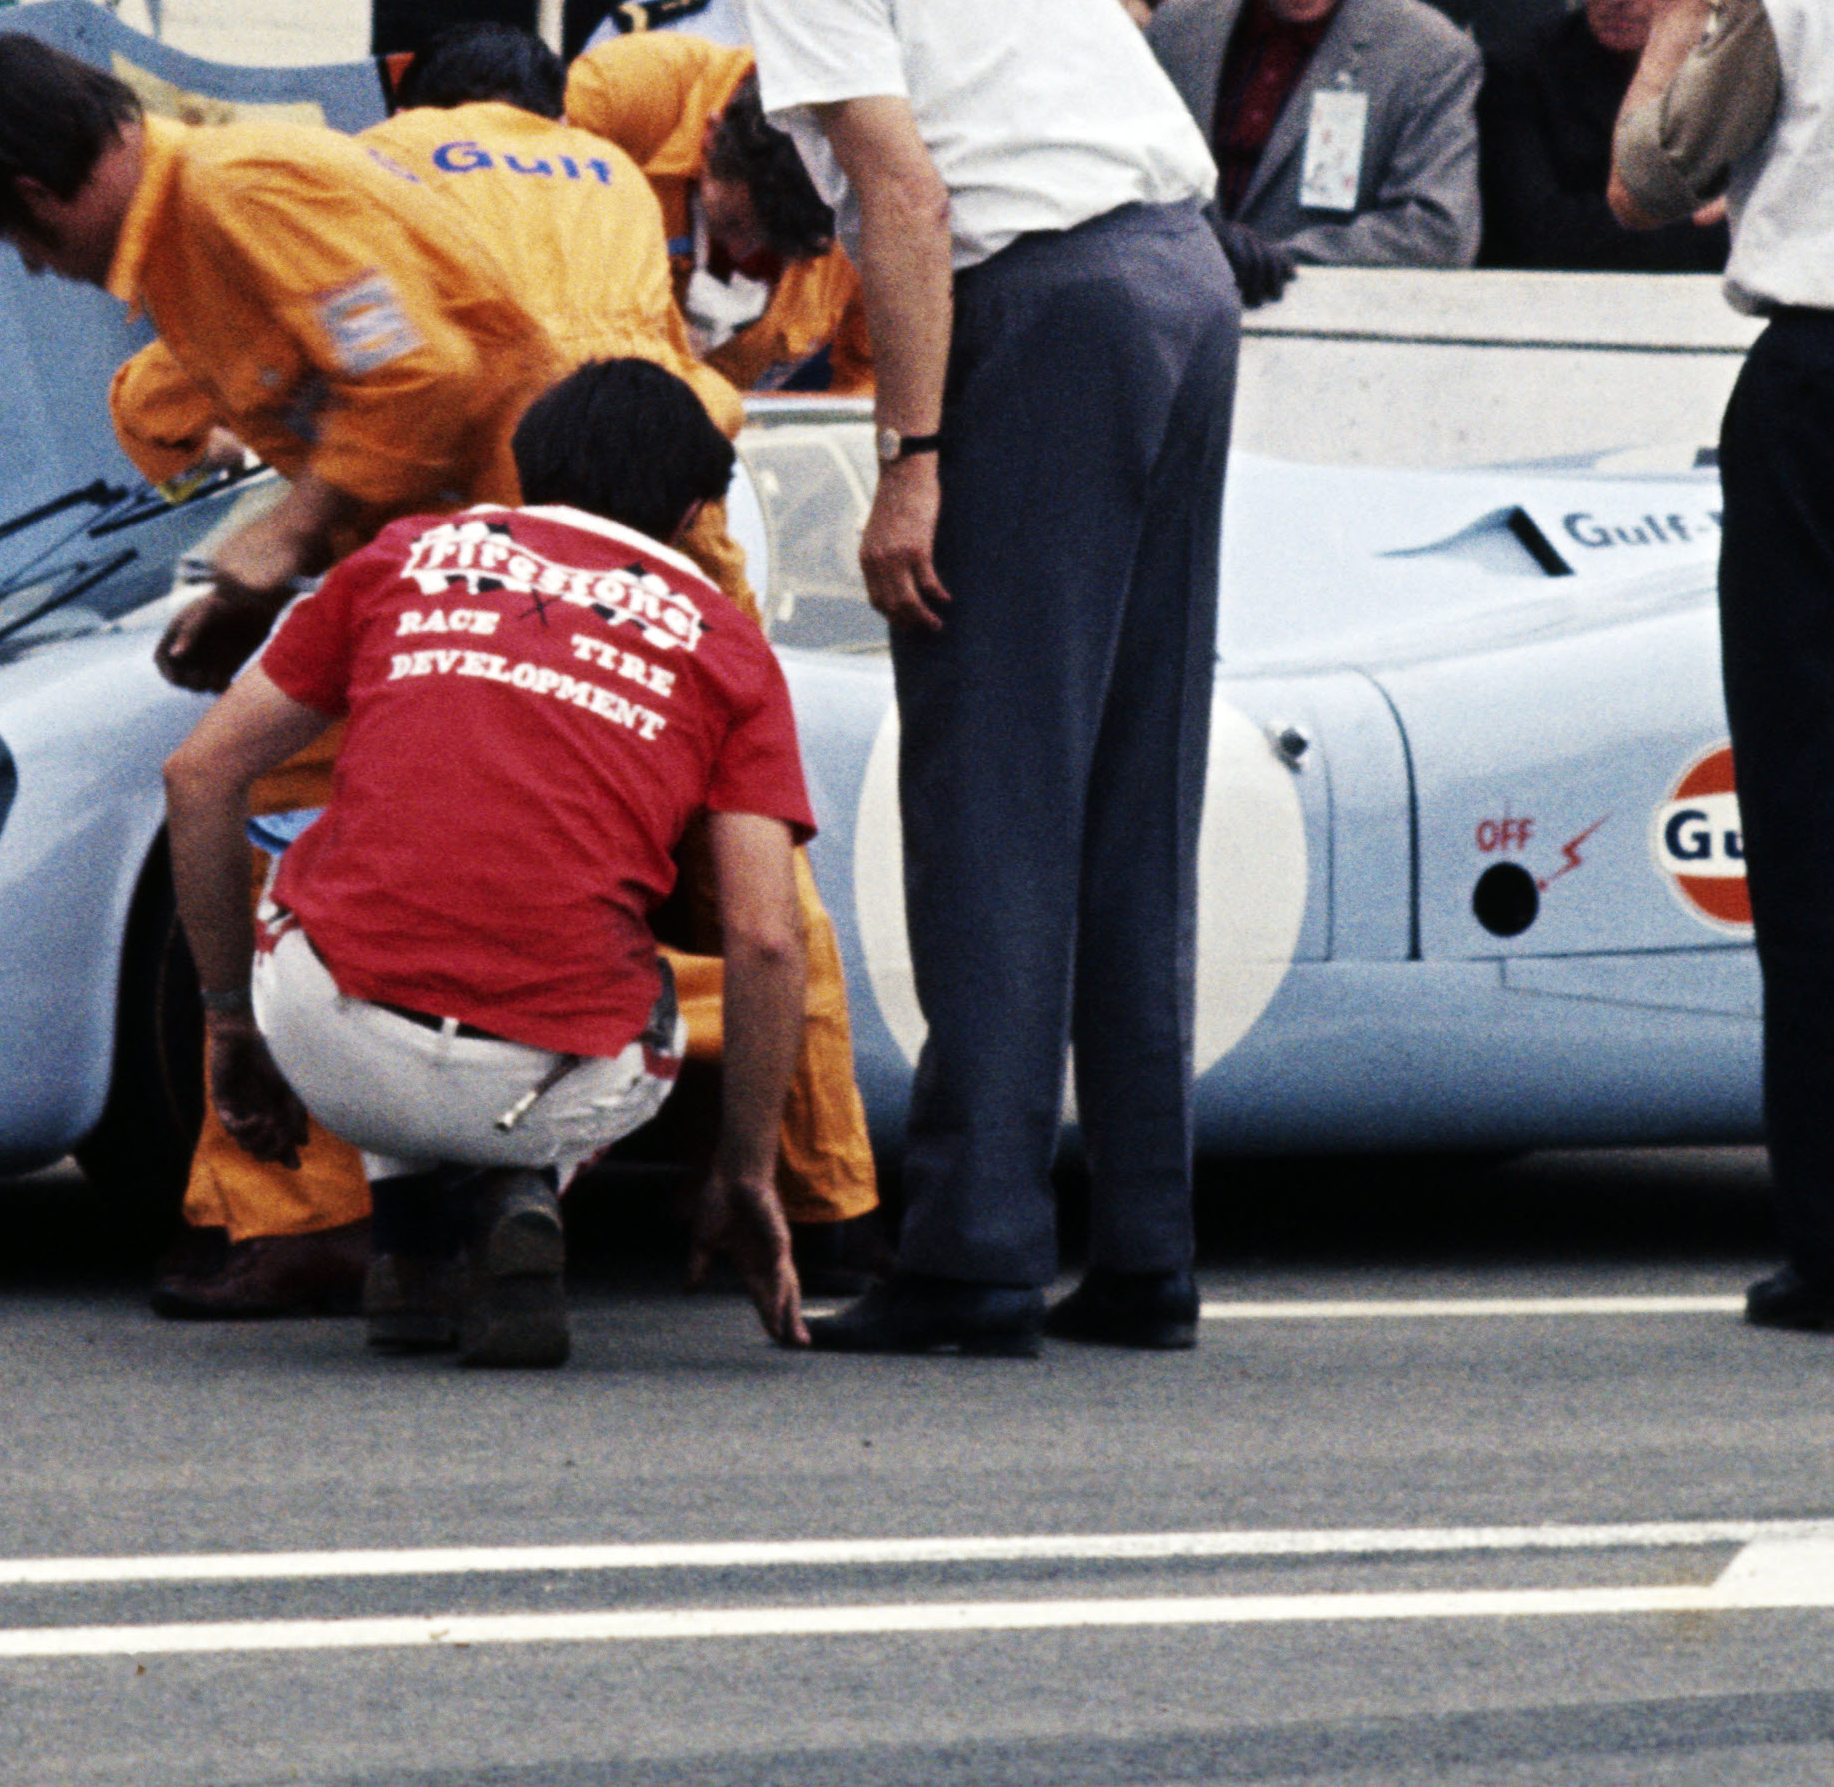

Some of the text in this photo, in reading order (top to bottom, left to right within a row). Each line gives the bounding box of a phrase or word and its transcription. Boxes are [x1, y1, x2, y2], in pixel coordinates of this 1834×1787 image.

[421, 534, 694, 638] Firestone
[388, 647, 667, 741] DEVELOPMENT
[396, 607, 676, 699] RACE TIRE
[1474, 816, 1534, 853] OFF
